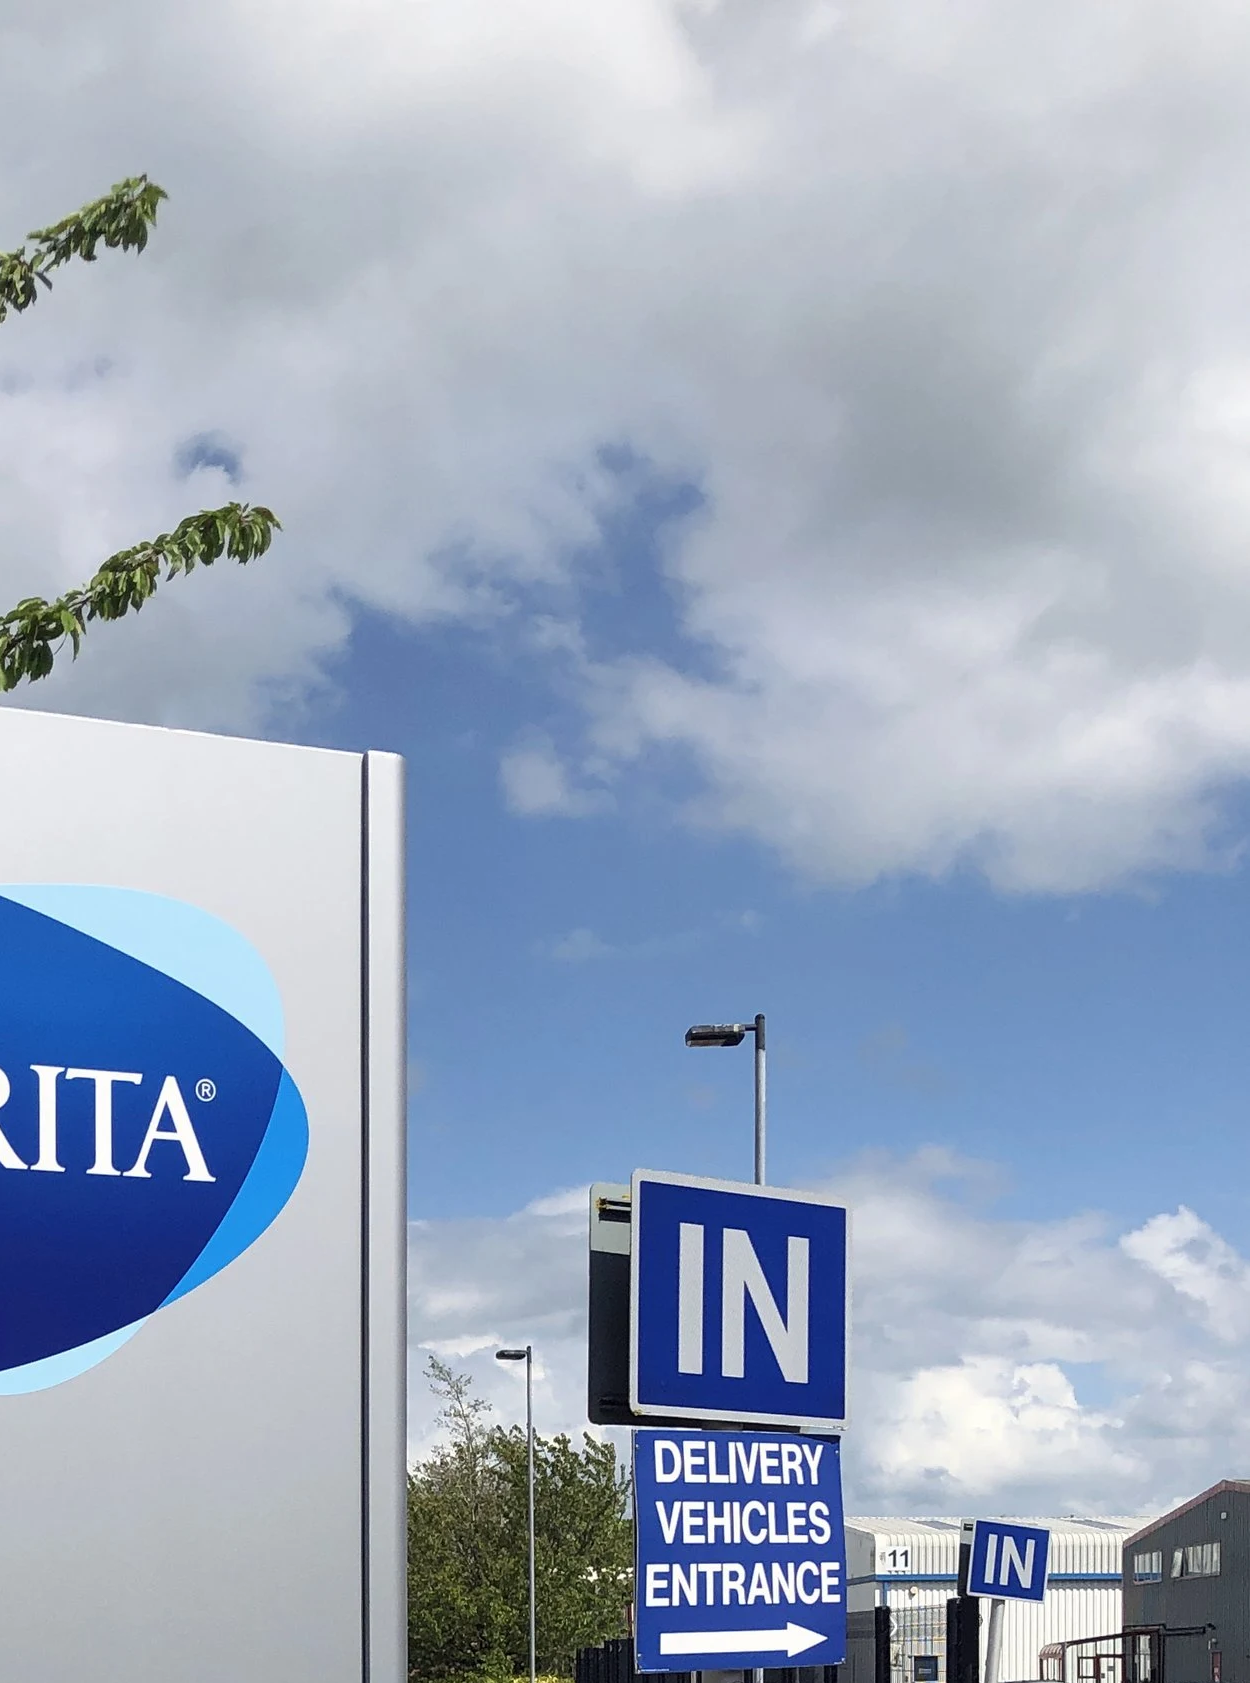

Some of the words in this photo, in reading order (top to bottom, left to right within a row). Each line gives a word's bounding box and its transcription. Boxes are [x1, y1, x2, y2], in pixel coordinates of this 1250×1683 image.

[678, 1222, 810, 1385] IN
[654, 1439, 823, 1486] DELIVERY
[655, 1500, 832, 1546] VEHICLES
[888, 1549, 909, 1568] 11
[983, 1532, 1036, 1589] IN
[645, 1560, 841, 1607] ENTRANCE
